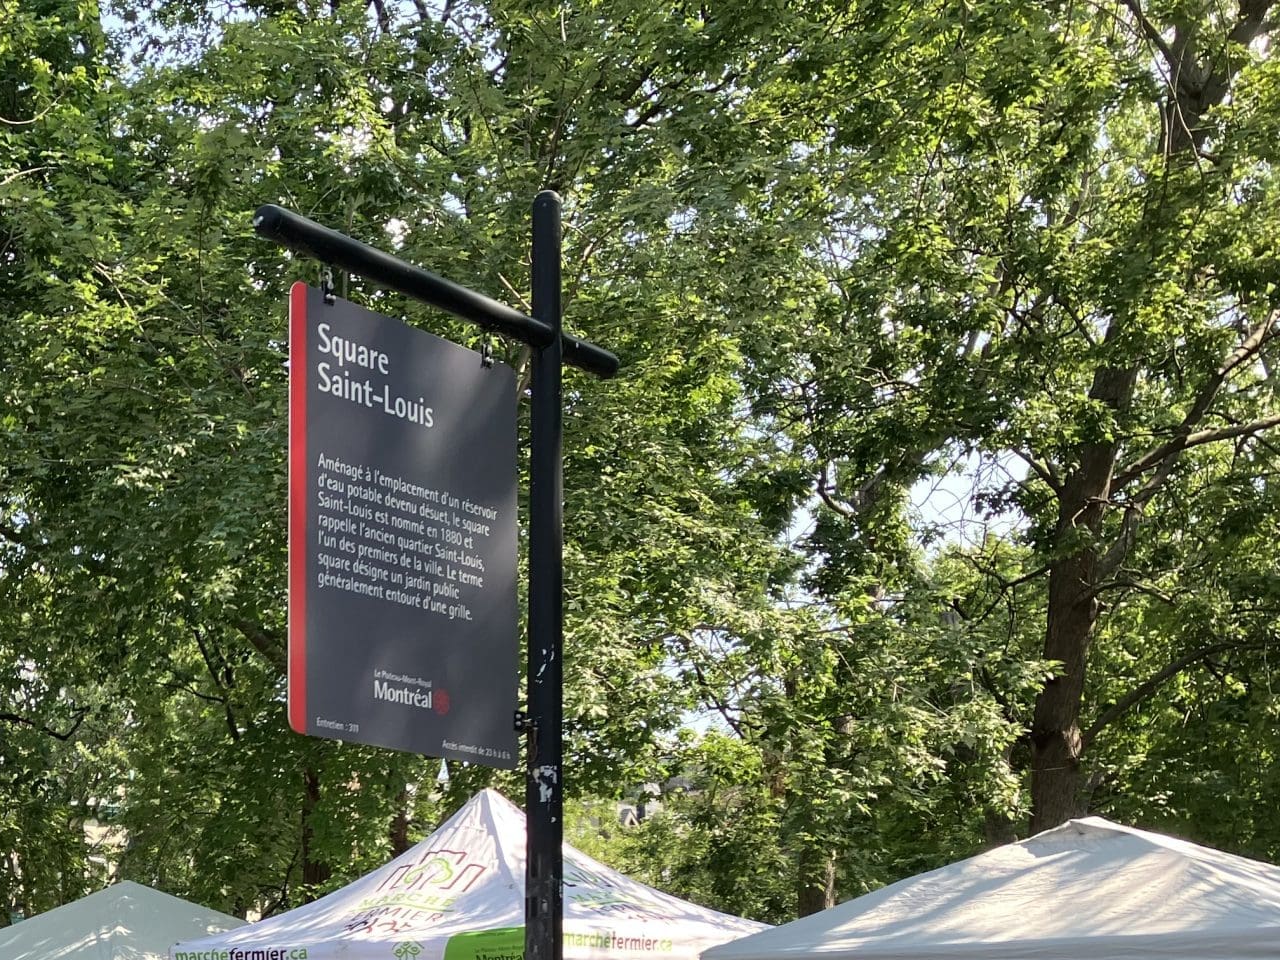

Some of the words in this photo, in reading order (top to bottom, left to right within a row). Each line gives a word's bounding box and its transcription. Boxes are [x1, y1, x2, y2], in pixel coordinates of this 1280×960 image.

[318, 323, 389, 375] Square
[318, 363, 434, 427] Saint-Louis
[318, 453, 363, 482] Aménagé
[366, 467, 371, 482] à
[374, 469, 439, 503] l'emplacement
[441, 492, 460, 508] d'un
[462, 499, 497, 521] réservoir
[318, 473, 345, 493] d'eau
[347, 484, 382, 504] potable
[385, 492, 417, 514] devenu
[419, 503, 451, 526] désuet,
[452, 512, 460, 526] le
[462, 518, 490, 537] square
[318, 491, 372, 520] Saint-Louis
[375, 509, 389, 525] est
[391, 515, 425, 535] nommé
[427, 526, 437, 539] en
[441, 527, 462, 546] 1880
[464, 536, 473, 549] et
[318, 514, 357, 533] rappelle
[359, 521, 395, 545] l'ancien
[397, 534, 433, 555] quartier
[435, 543, 485, 572] Saint-Louis,
[318, 530, 336, 548] l'un
[339, 536, 355, 554] des
[358, 542, 398, 565] premiers
[400, 553, 412, 569] de
[414, 555, 422, 571] la
[424, 559, 444, 577] ville.
[447, 564, 456, 580] Le
[459, 570, 483, 588] terme
[318, 552, 350, 572] square
[353, 558, 389, 582] désigne
[391, 571, 403, 584] un
[405, 573, 431, 592] jardin
[433, 582, 460, 599] public
[318, 571, 384, 599] généralement
[385, 588, 420, 607] entouré
[423, 596, 447, 614] d'une
[449, 603, 473, 621] grille.
[374, 680, 432, 709] Montréal
[316, 717, 344, 731] Entretien
